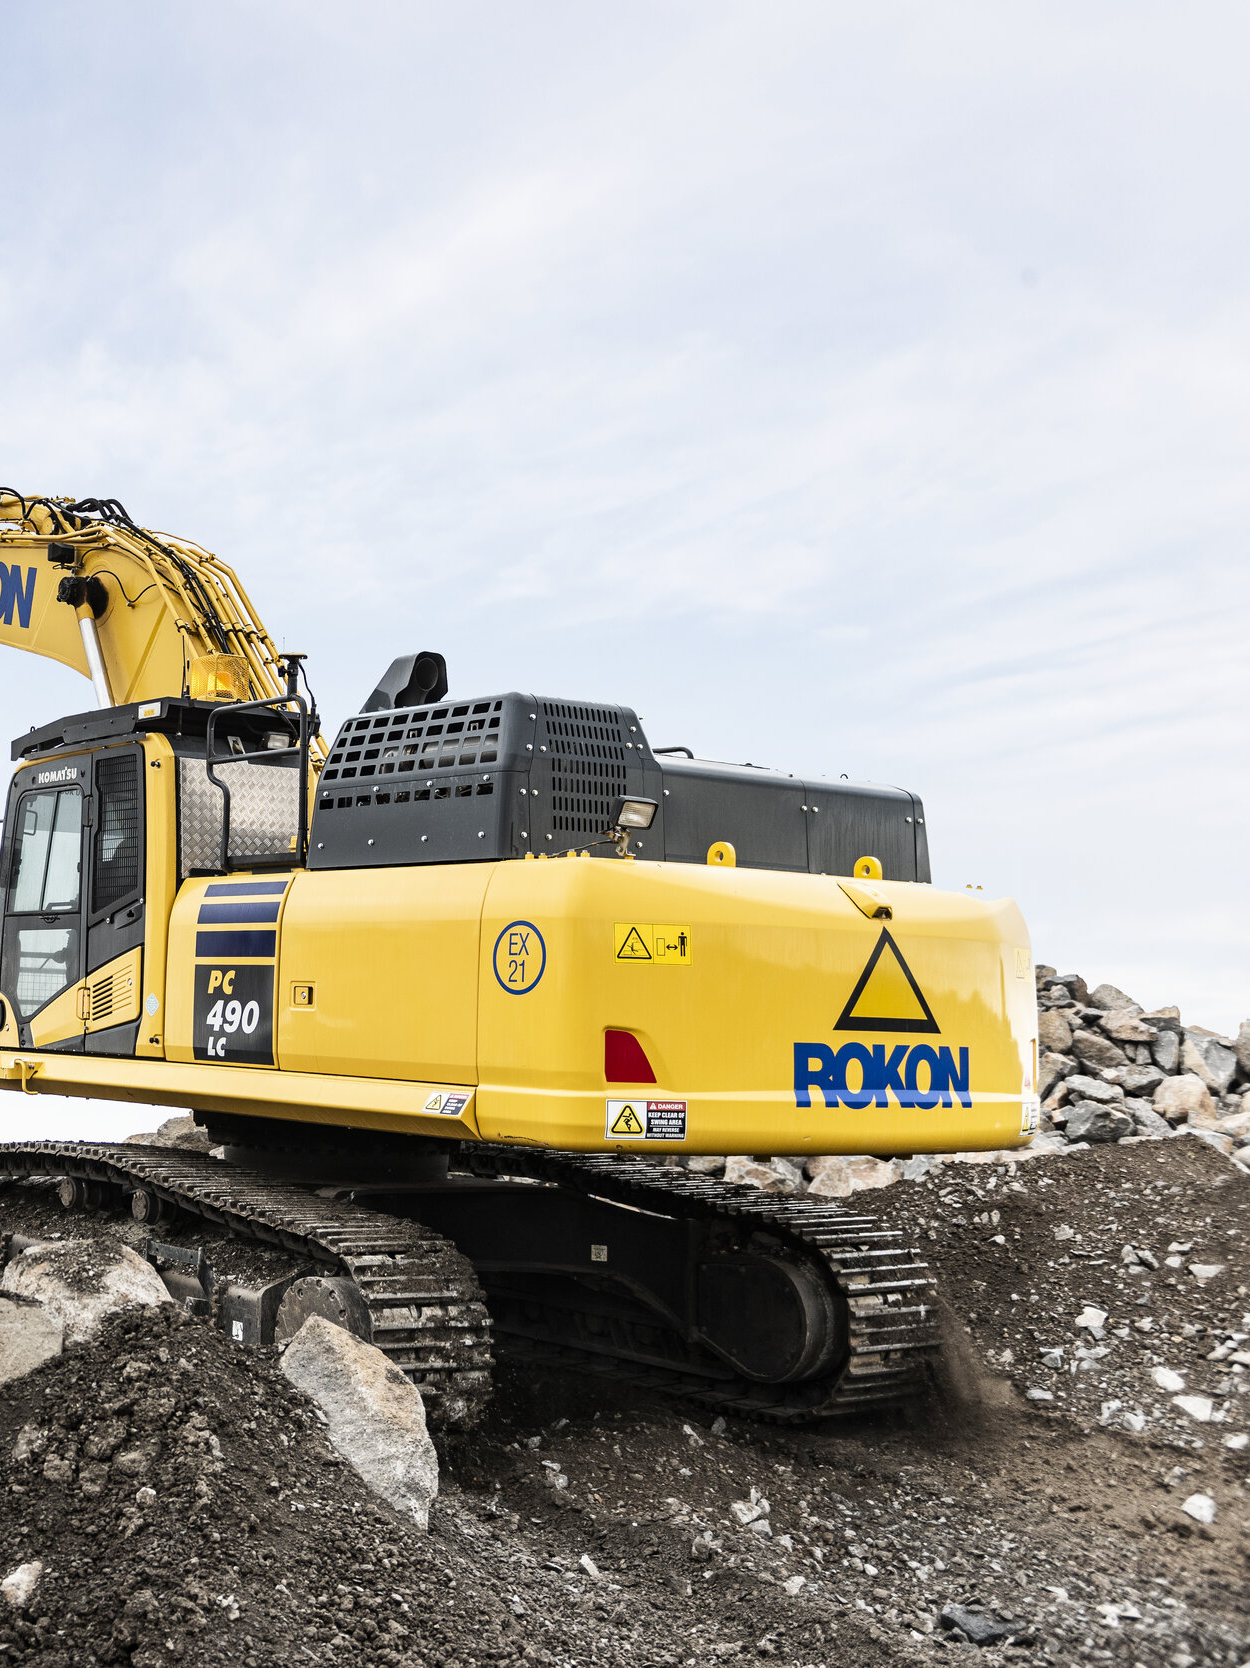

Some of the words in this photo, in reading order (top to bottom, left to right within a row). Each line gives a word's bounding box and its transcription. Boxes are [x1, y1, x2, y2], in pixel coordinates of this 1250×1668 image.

[38, 766, 77, 784] KOMATSU
[508, 932, 530, 956] EX
[207, 970, 236, 995] PC
[508, 959, 525, 982] 21
[206, 1000, 260, 1034] 490
[207, 1036, 227, 1057] LC
[793, 1042, 972, 1110] ROKON
